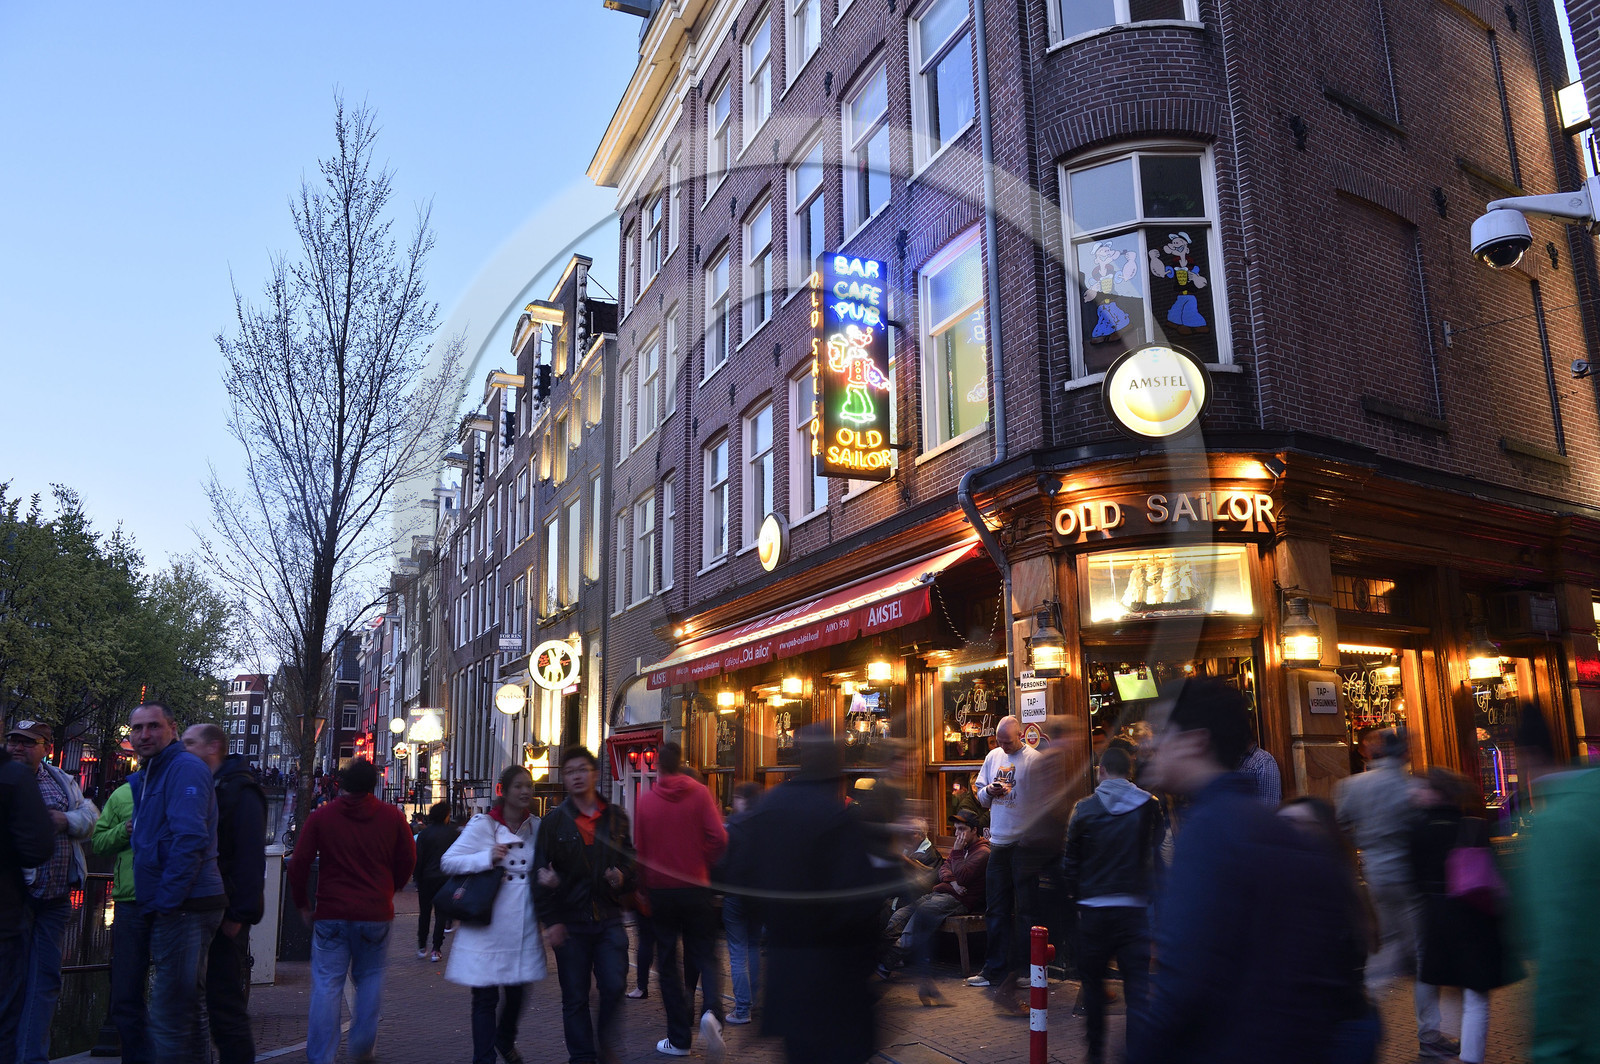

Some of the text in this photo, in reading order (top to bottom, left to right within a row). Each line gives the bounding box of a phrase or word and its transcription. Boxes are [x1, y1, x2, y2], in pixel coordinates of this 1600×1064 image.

[834, 255, 880, 279] BAR
[810, 271, 820, 328] OLD
[833, 281, 882, 306] CAFE
[832, 301, 882, 327] PUB
[1129, 375, 1187, 391] AMSTEL
[836, 427, 883, 450] OLD
[826, 446, 892, 470] SAILOR
[1055, 501, 1121, 536] OLD
[1021, 681, 1047, 689] PERSONEN
[1316, 686, 1330, 697] TAP-
[1022, 707, 1046, 718] VERGUNNING
[1026, 697, 1039, 706] TAP-
[1310, 698, 1338, 707] VERGUNNING
